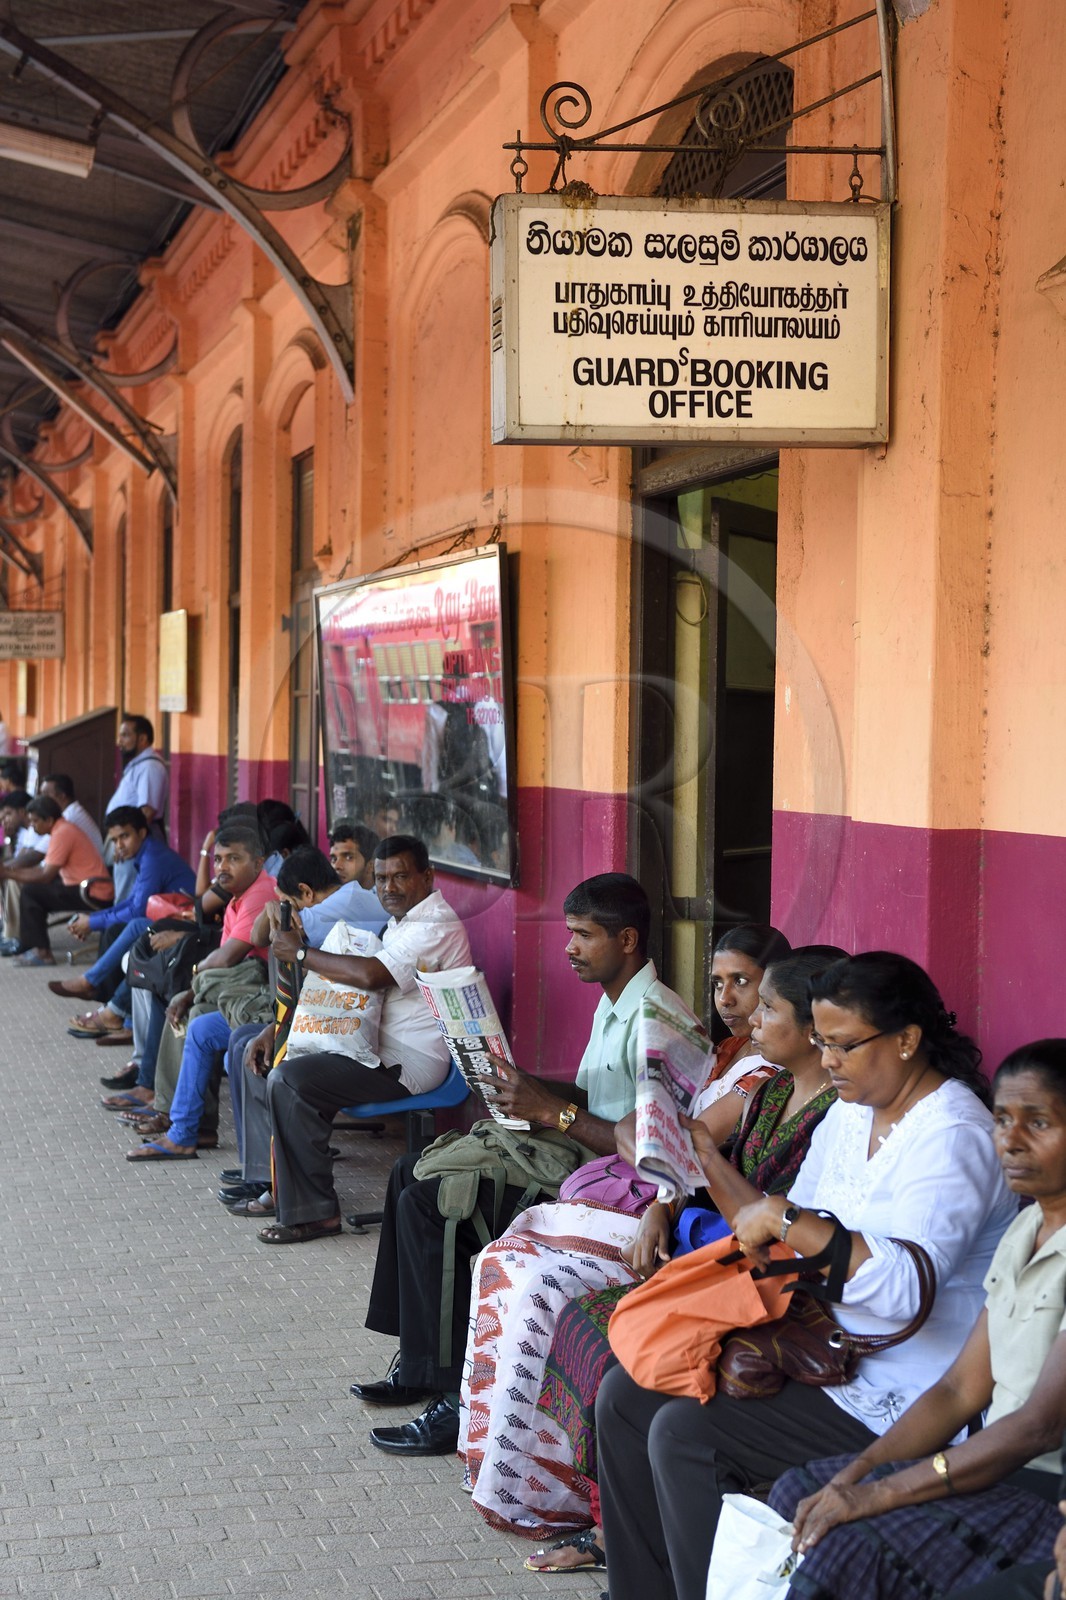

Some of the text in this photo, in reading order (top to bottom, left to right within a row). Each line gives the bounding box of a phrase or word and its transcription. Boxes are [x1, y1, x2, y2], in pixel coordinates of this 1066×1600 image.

[644, 229, 741, 266] සැලසුම්
[554, 279, 849, 313] பாதுகாப்பு உத்தியோகத்தர்
[553, 308, 841, 340] பதிவுசெய்யும் காரியாலயம்
[690, 358, 829, 390] BOOKING
[648, 390, 753, 419] OFFICE
